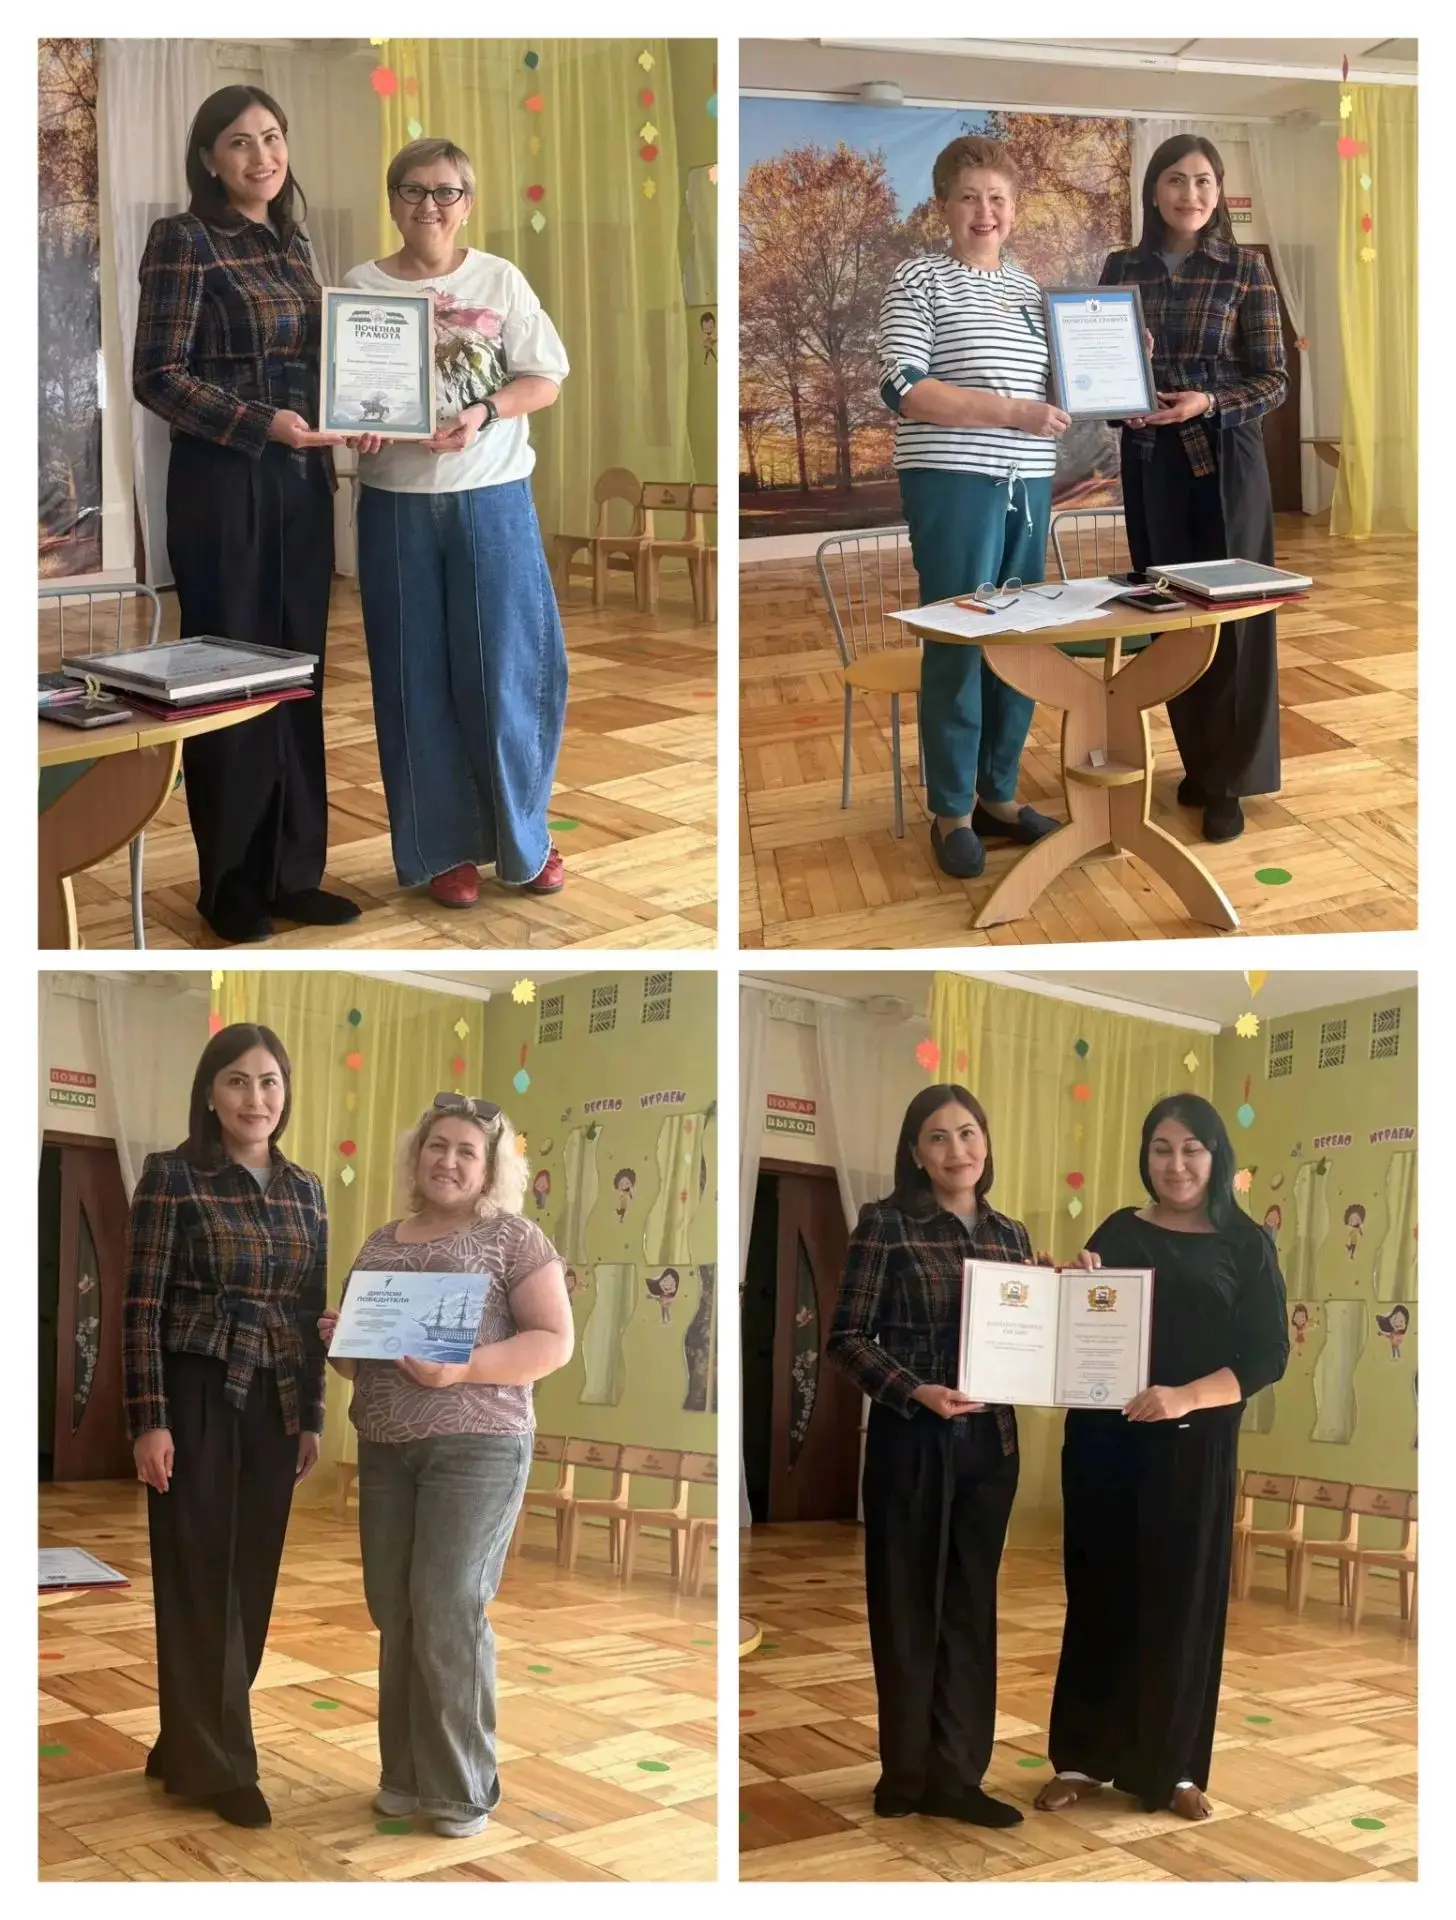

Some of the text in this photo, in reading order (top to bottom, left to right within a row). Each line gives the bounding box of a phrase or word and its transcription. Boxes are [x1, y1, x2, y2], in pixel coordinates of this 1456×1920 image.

[355, 331, 401, 339] ГРАМОТА
[52, 1071, 95, 1085] ПОЖАР
[51, 1090, 95, 1105] ВЫХОД
[584, 1091, 686, 1114] ВЕСЕЛО ИГРАЕМ
[769, 1098, 814, 1112] ПОЖАР
[768, 1117, 814, 1132] ВЫХОД
[1314, 1128, 1414, 1149] ВЕСЕЛО ИГРАЕМ
